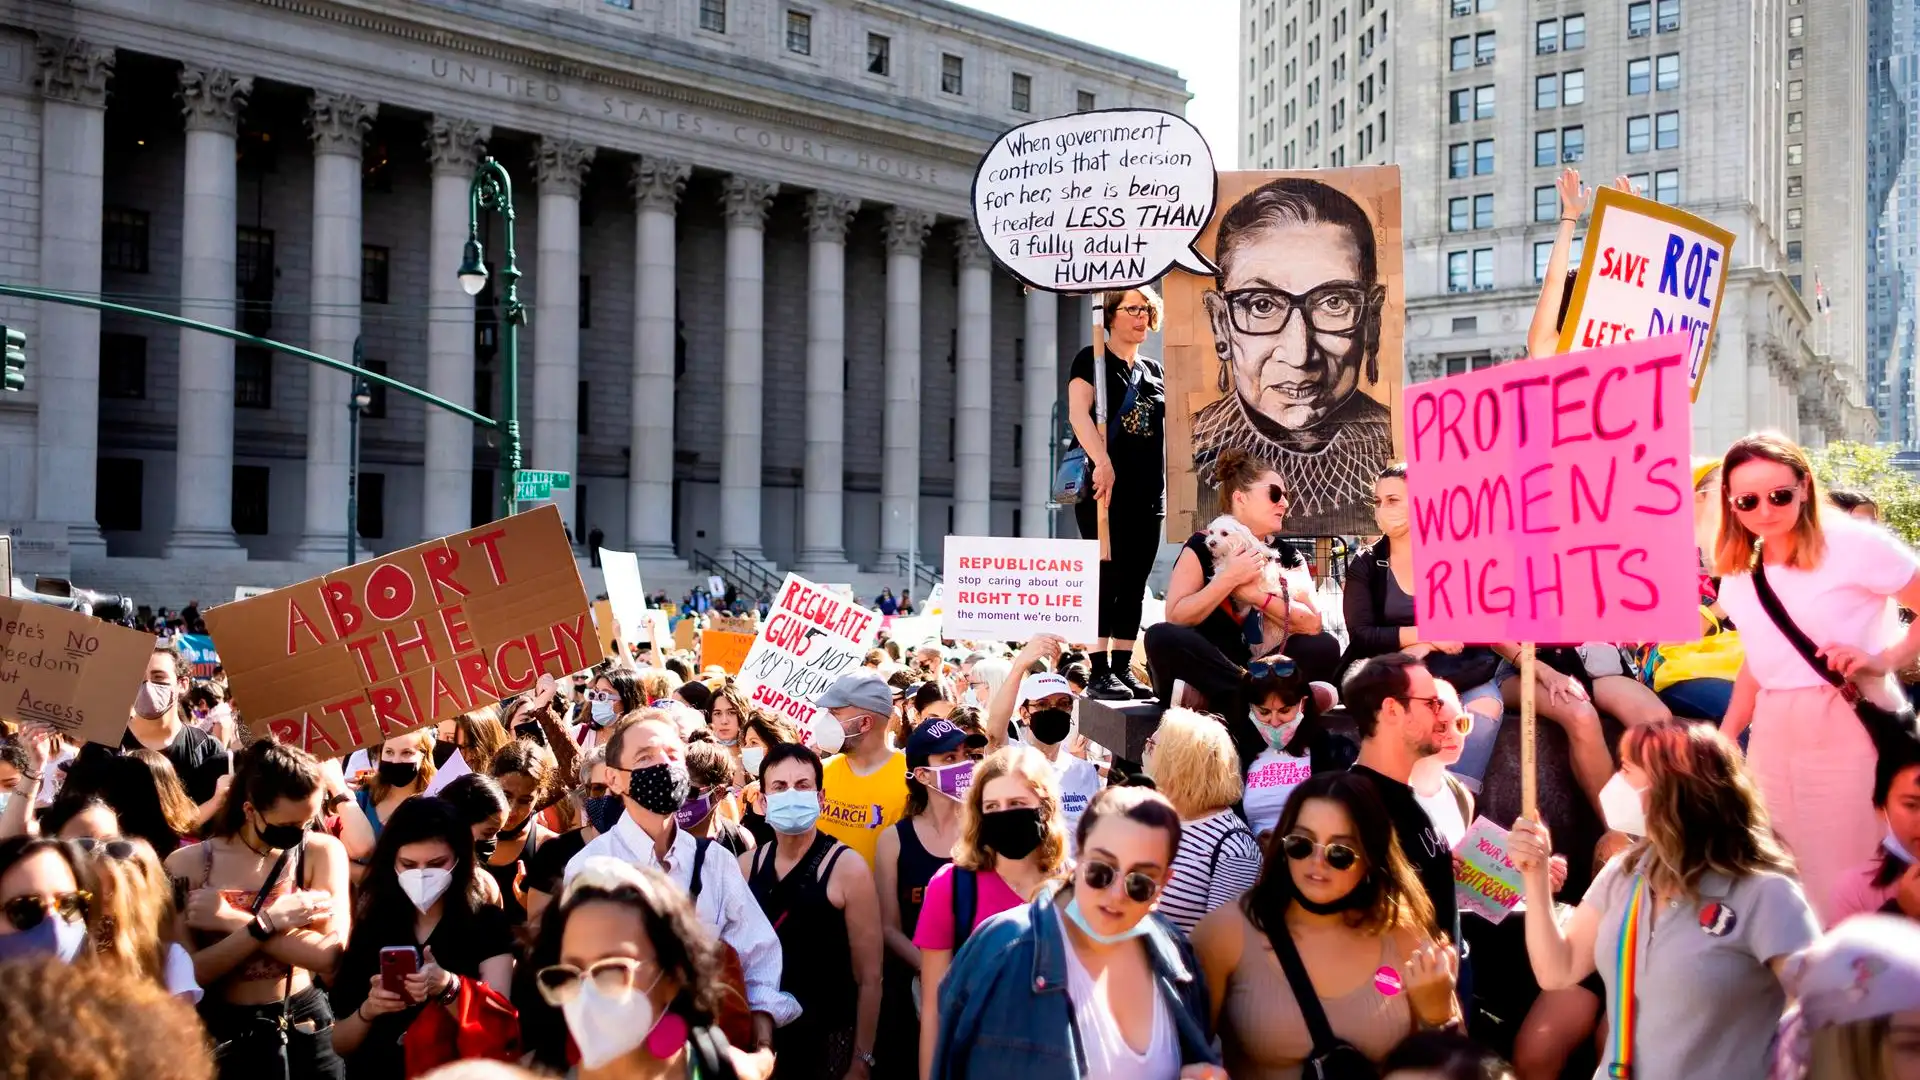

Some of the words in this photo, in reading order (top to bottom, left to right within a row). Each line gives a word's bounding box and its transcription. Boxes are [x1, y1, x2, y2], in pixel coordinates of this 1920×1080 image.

[430, 58, 562, 104] UNITED
[603, 96, 703, 134] STATES
[734, 125, 831, 160] COURT
[857, 152, 938, 184] HOUSE
[1006, 132, 1050, 157] When
[1056, 116, 1171, 156] government
[988, 157, 1064, 184] controls
[1072, 150, 1111, 174] that
[1119, 149, 1192, 168] decision
[983, 191, 1015, 211] for
[1019, 184, 1051, 204] her,
[1062, 180, 1093, 200] she
[1104, 182, 1118, 198] is
[1128, 175, 1180, 203] being
[992, 210, 1055, 236] treated
[1065, 206, 1126, 229] LESS
[1136, 204, 1204, 228] THAN
[1009, 239, 1020, 256] a
[1026, 234, 1073, 262] fully
[1083, 234, 1149, 254] adult
[1054, 257, 1146, 284] HUMAN
[1599, 246, 1650, 288] SAVE
[1658, 233, 1719, 308] ROE
[1582, 318, 1635, 348] LET'S
[1412, 354, 1682, 462] PROTECT
[517, 483, 537, 497] PEARL
[1413, 444, 1683, 546] WOMEN'S
[959, 557, 1084, 572] REPUBLICANS
[287, 529, 507, 655] ABORT
[958, 575, 981, 588] stop
[988, 576, 1021, 588] caring
[1028, 577, 1058, 588] about
[1065, 580, 1084, 588] our
[1425, 543, 1660, 620] RIGHTS
[780, 580, 872, 644] REGULATE
[959, 591, 1012, 604] RIGHT
[1017, 593, 1040, 606] TO
[1045, 594, 1083, 607] LIFE
[957, 609, 974, 619] the
[978, 611, 1020, 621] moment
[1023, 612, 1051, 622] we're
[1055, 612, 1083, 623] born.
[66, 630, 99, 652] NO
[345, 604, 475, 683] THE
[765, 613, 824, 657] GUNS
[0, 668, 20, 684] ut
[744, 649, 783, 680] MY
[783, 660, 835, 698] VAGIN
[806, 646, 862, 676] NOT
[268, 613, 588, 753] PATRIARCHY
[18, 688, 84, 722] Access
[752, 684, 817, 725] SUPPORT
[927, 718, 959, 738] VOT
[1262, 762, 1297, 770] NEVER
[821, 804, 867, 823] MARCH
[1476, 837, 1503, 860] YOUR
